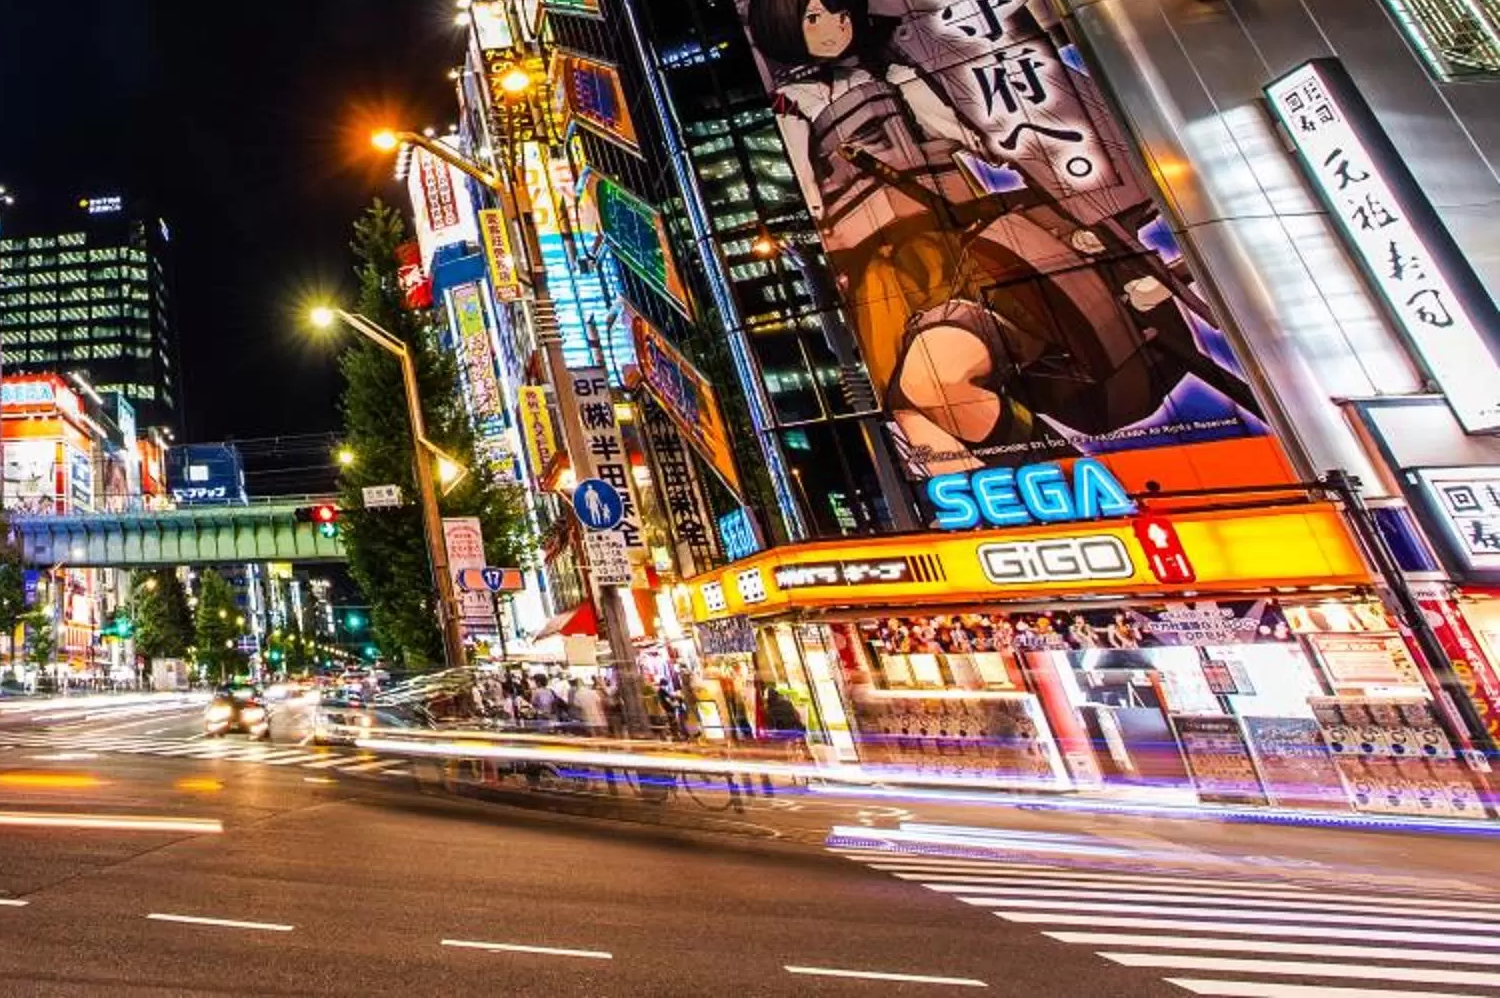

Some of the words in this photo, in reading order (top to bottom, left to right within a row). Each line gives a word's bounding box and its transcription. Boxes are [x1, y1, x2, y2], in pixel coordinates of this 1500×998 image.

[573, 378, 608, 397] 8F
[580, 402, 643, 549] (株)半田全
[927, 458, 1139, 531] SEGA
[485, 570, 501, 586] 17
[980, 536, 1128, 580] GiGO
